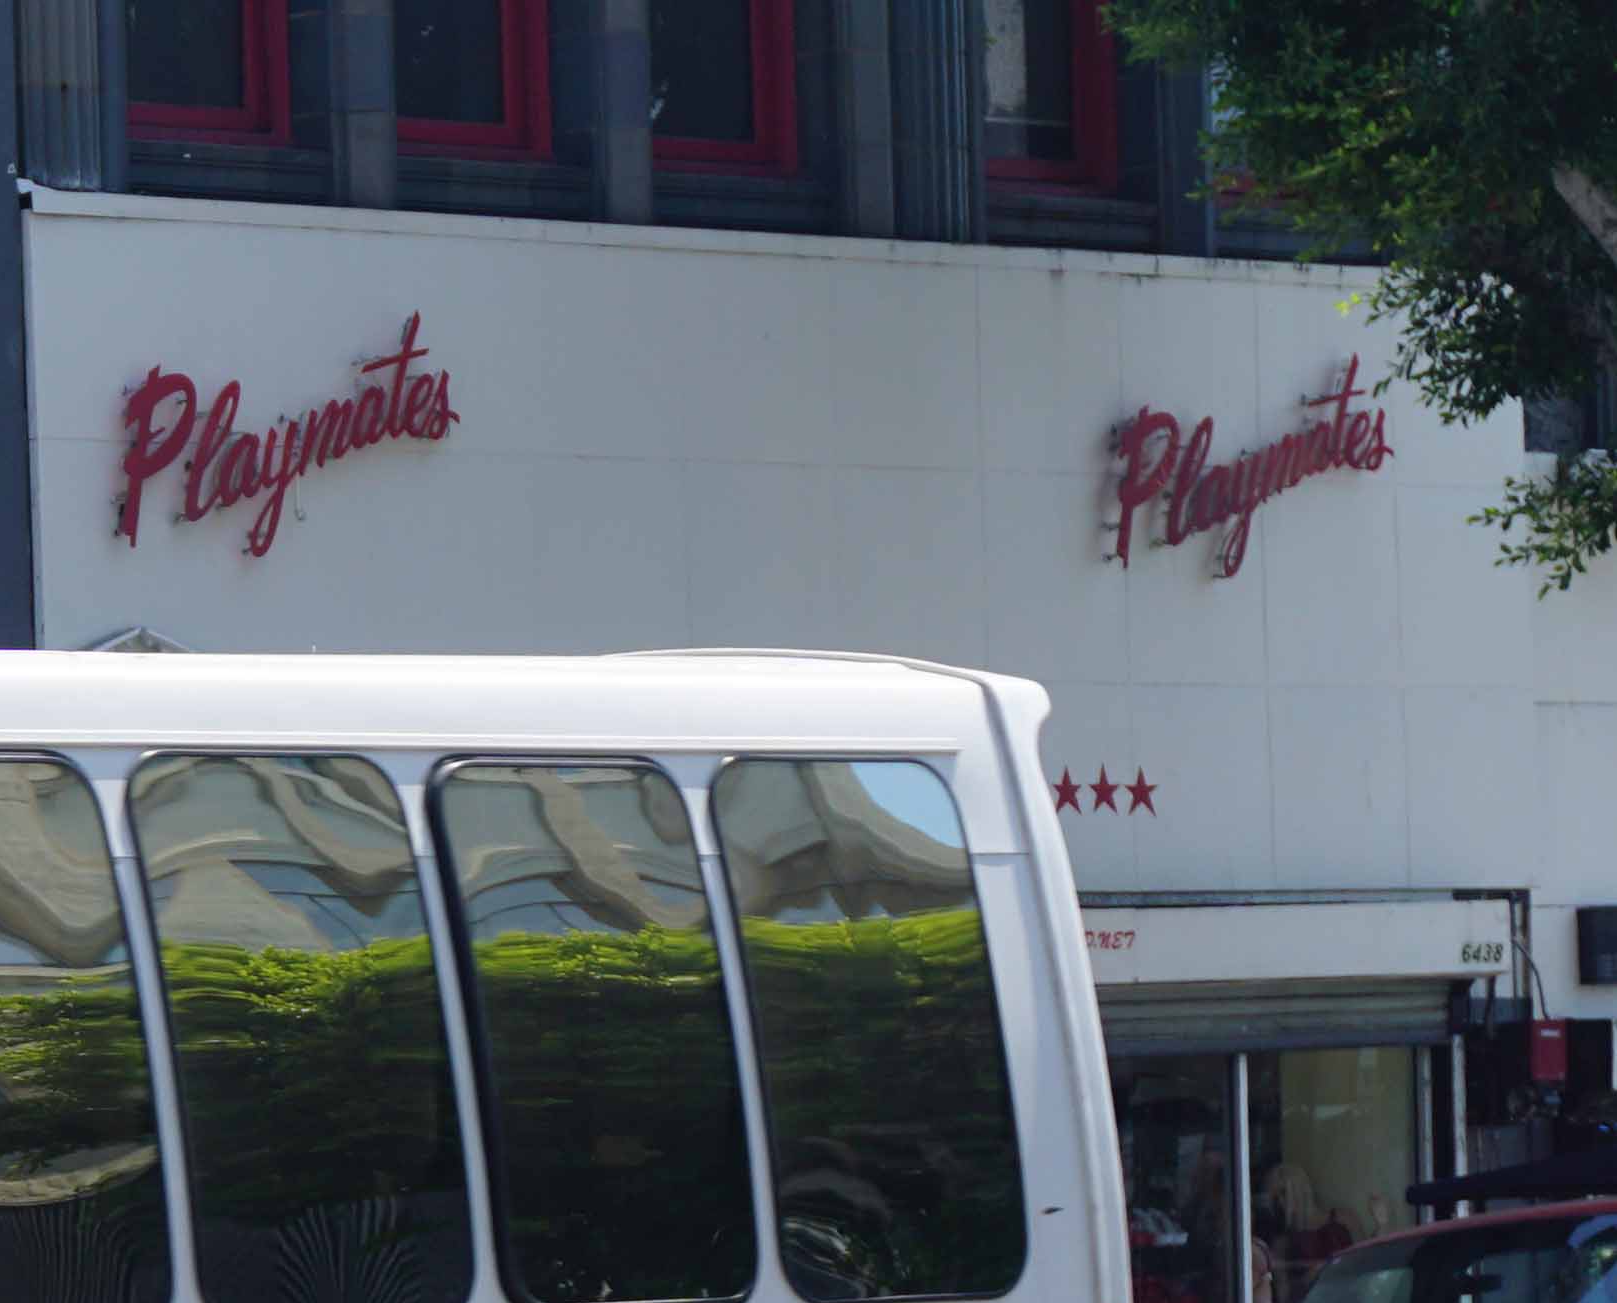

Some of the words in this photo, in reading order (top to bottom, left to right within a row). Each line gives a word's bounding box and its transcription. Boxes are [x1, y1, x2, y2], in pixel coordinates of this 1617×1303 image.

[122, 310, 460, 558] Playmates
[1115, 352, 1395, 578] Playmates
[1460, 942, 1504, 964] 6438
